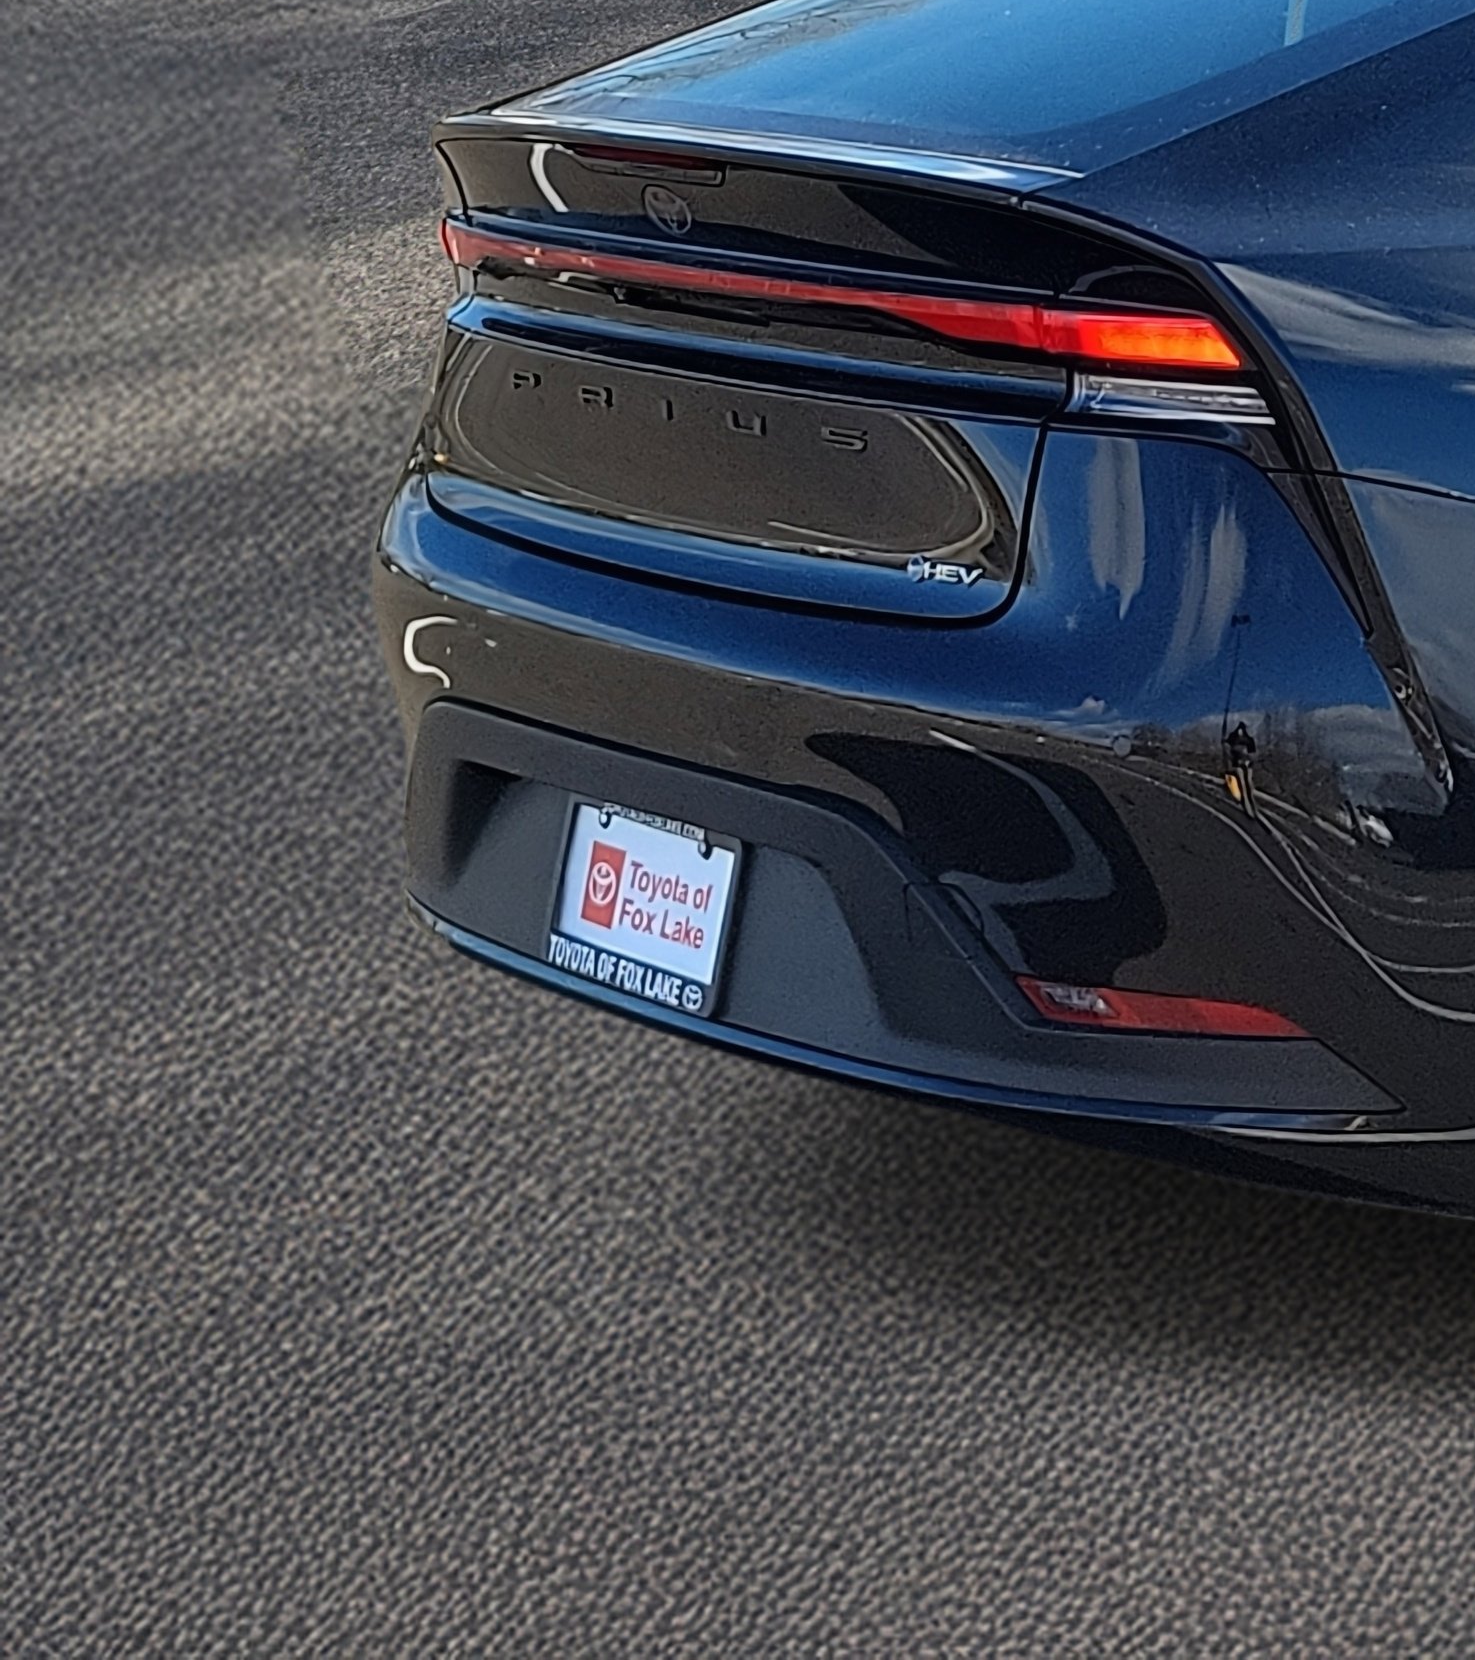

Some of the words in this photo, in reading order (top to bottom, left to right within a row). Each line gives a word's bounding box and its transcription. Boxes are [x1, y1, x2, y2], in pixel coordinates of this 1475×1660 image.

[512, 370, 869, 453] PRIUS
[923, 561, 983, 584] HEV
[629, 860, 688, 903] Toyota
[693, 883, 713, 914] of
[618, 899, 656, 935] Fox
[659, 909, 705, 949] Lake
[549, 935, 596, 974] TOYOTA
[597, 952, 617, 983] OF
[616, 959, 645, 994] FOX
[645, 969, 682, 1006] LAKE
